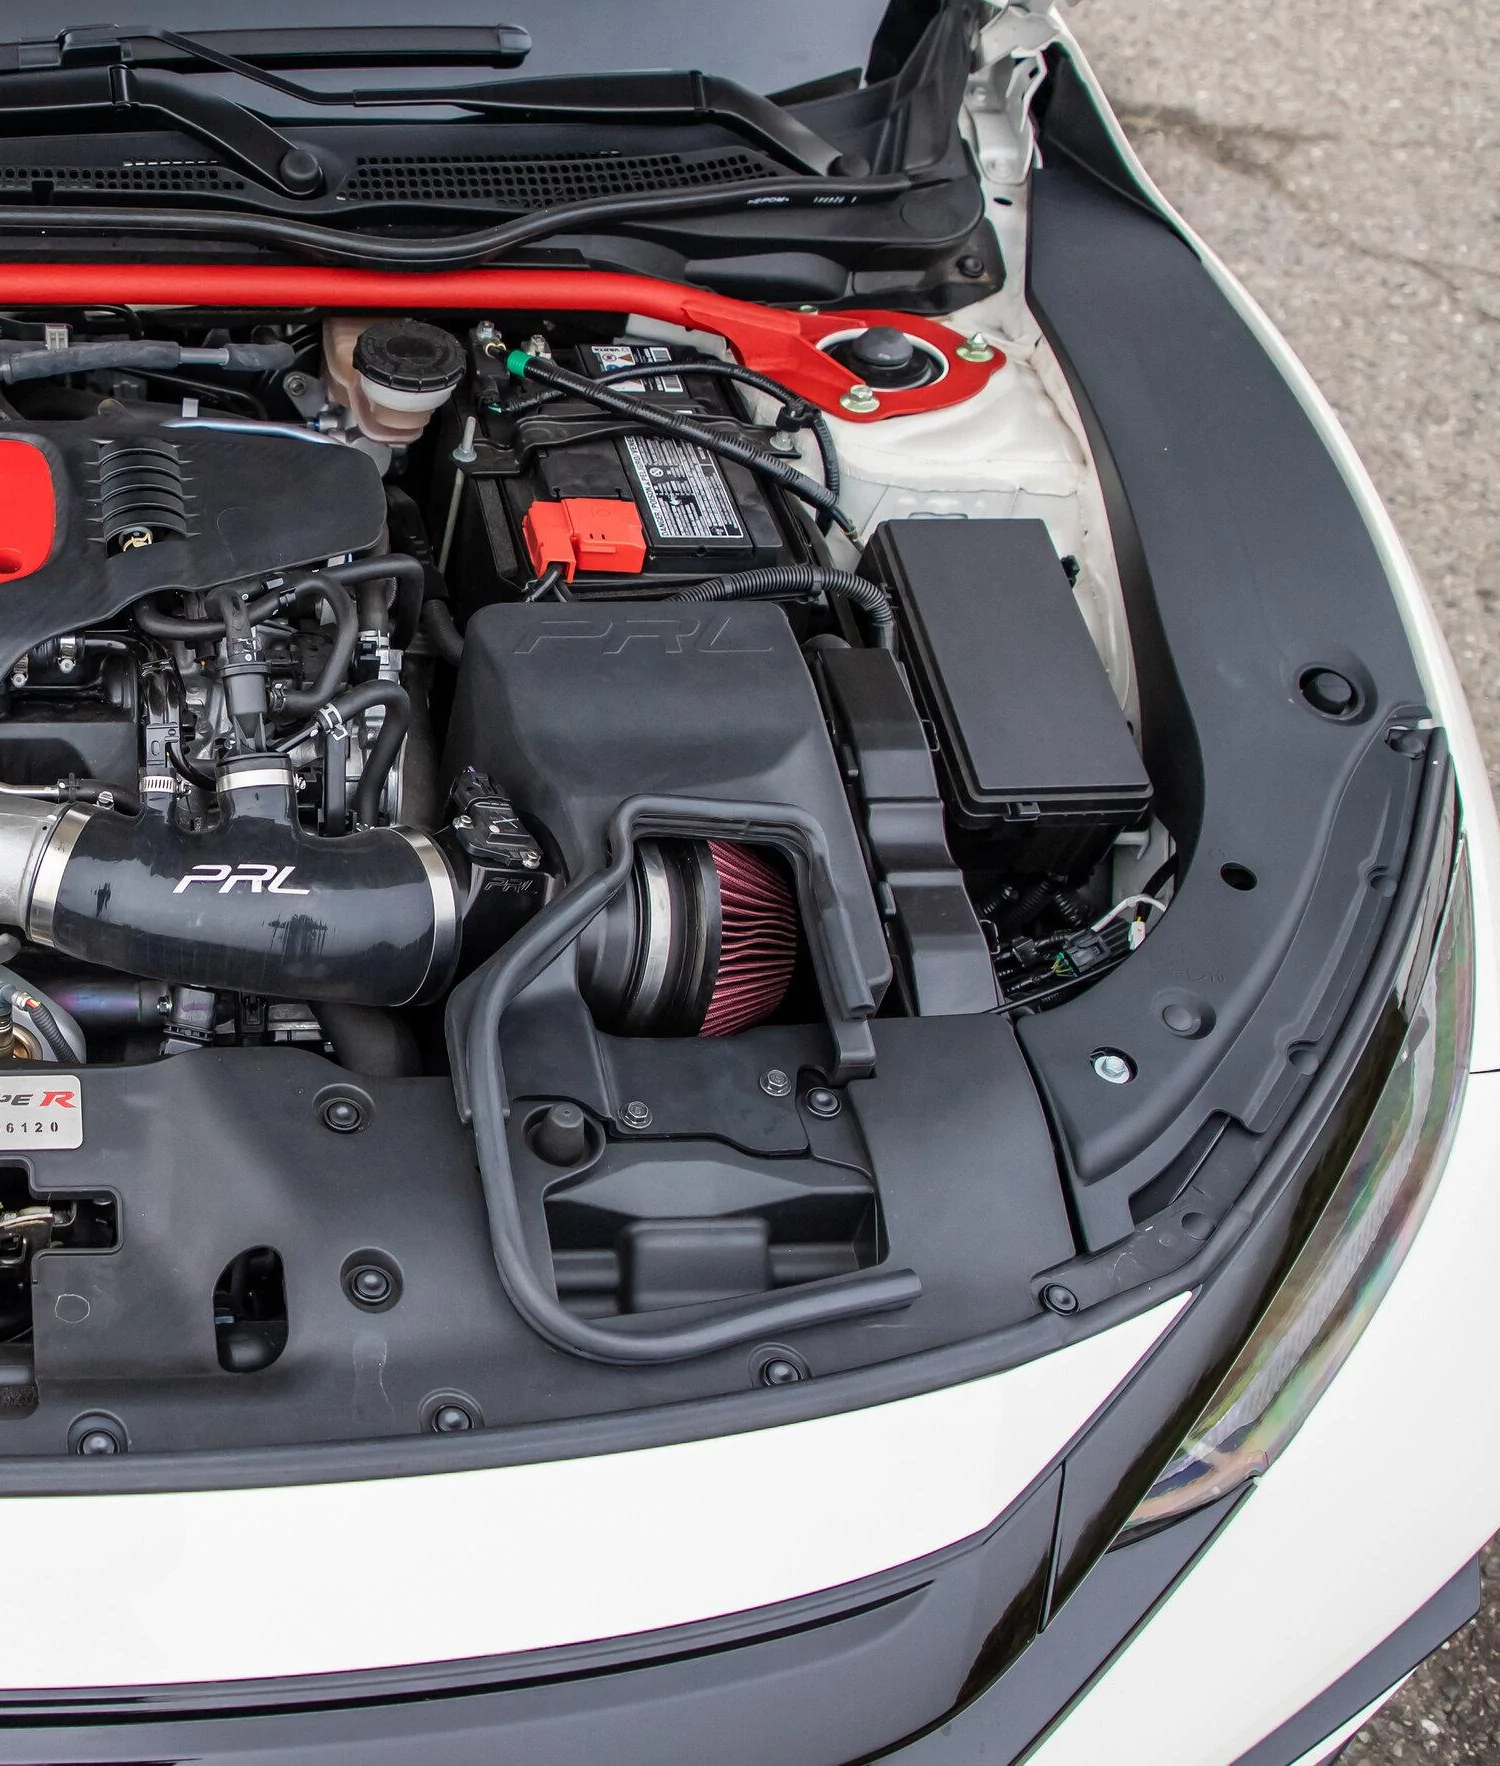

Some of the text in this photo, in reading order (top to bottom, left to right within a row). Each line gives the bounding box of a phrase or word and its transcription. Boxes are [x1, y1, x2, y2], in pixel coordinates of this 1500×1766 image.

[512, 617, 774, 655] PRL
[172, 863, 310, 895] PRL
[484, 876, 538, 895] PRL
[39, 1091, 76, 1108] R
